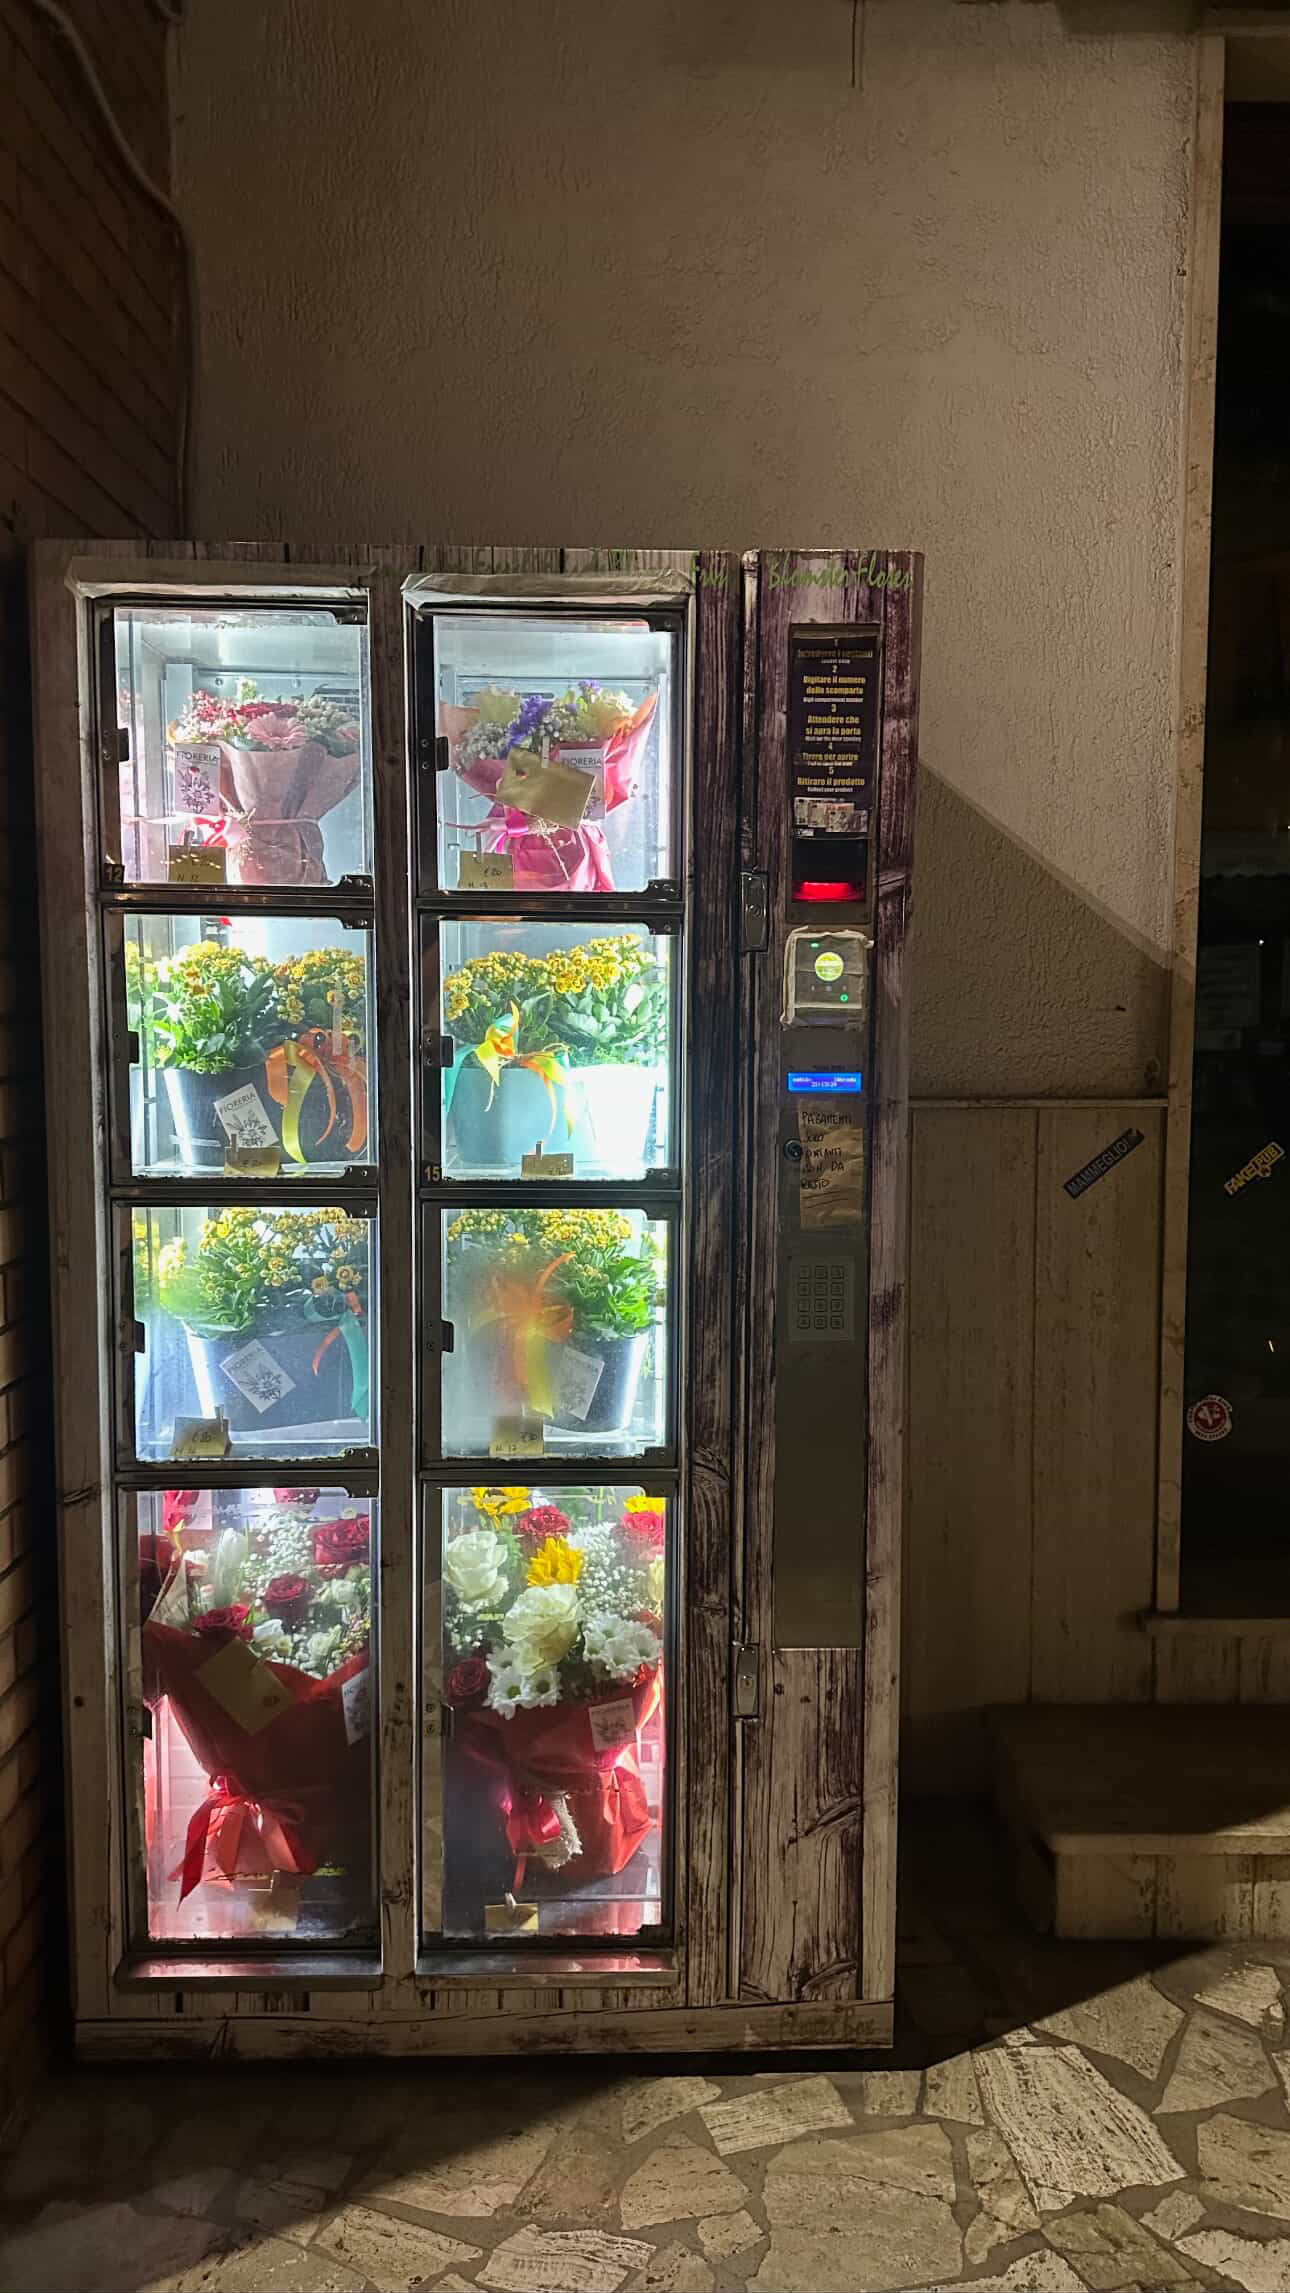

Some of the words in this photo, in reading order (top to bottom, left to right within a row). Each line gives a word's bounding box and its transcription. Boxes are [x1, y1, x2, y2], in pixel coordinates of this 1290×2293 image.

[832, 665, 838, 673] 2
[839, 676, 866, 684] numero
[825, 686, 864, 696] scomparto
[831, 703, 837, 712] 3
[807, 715, 844, 724] Attendere
[845, 715, 860, 724] che
[805, 726, 812, 735] si
[813, 727, 831, 736] apra
[832, 726, 840, 735] la
[840, 727, 861, 736] porta
[829, 767, 834, 775] 5
[833, 777, 865, 787] prodotto
[107, 866, 121, 881] 12
[424, 1166, 441, 1182] 15
